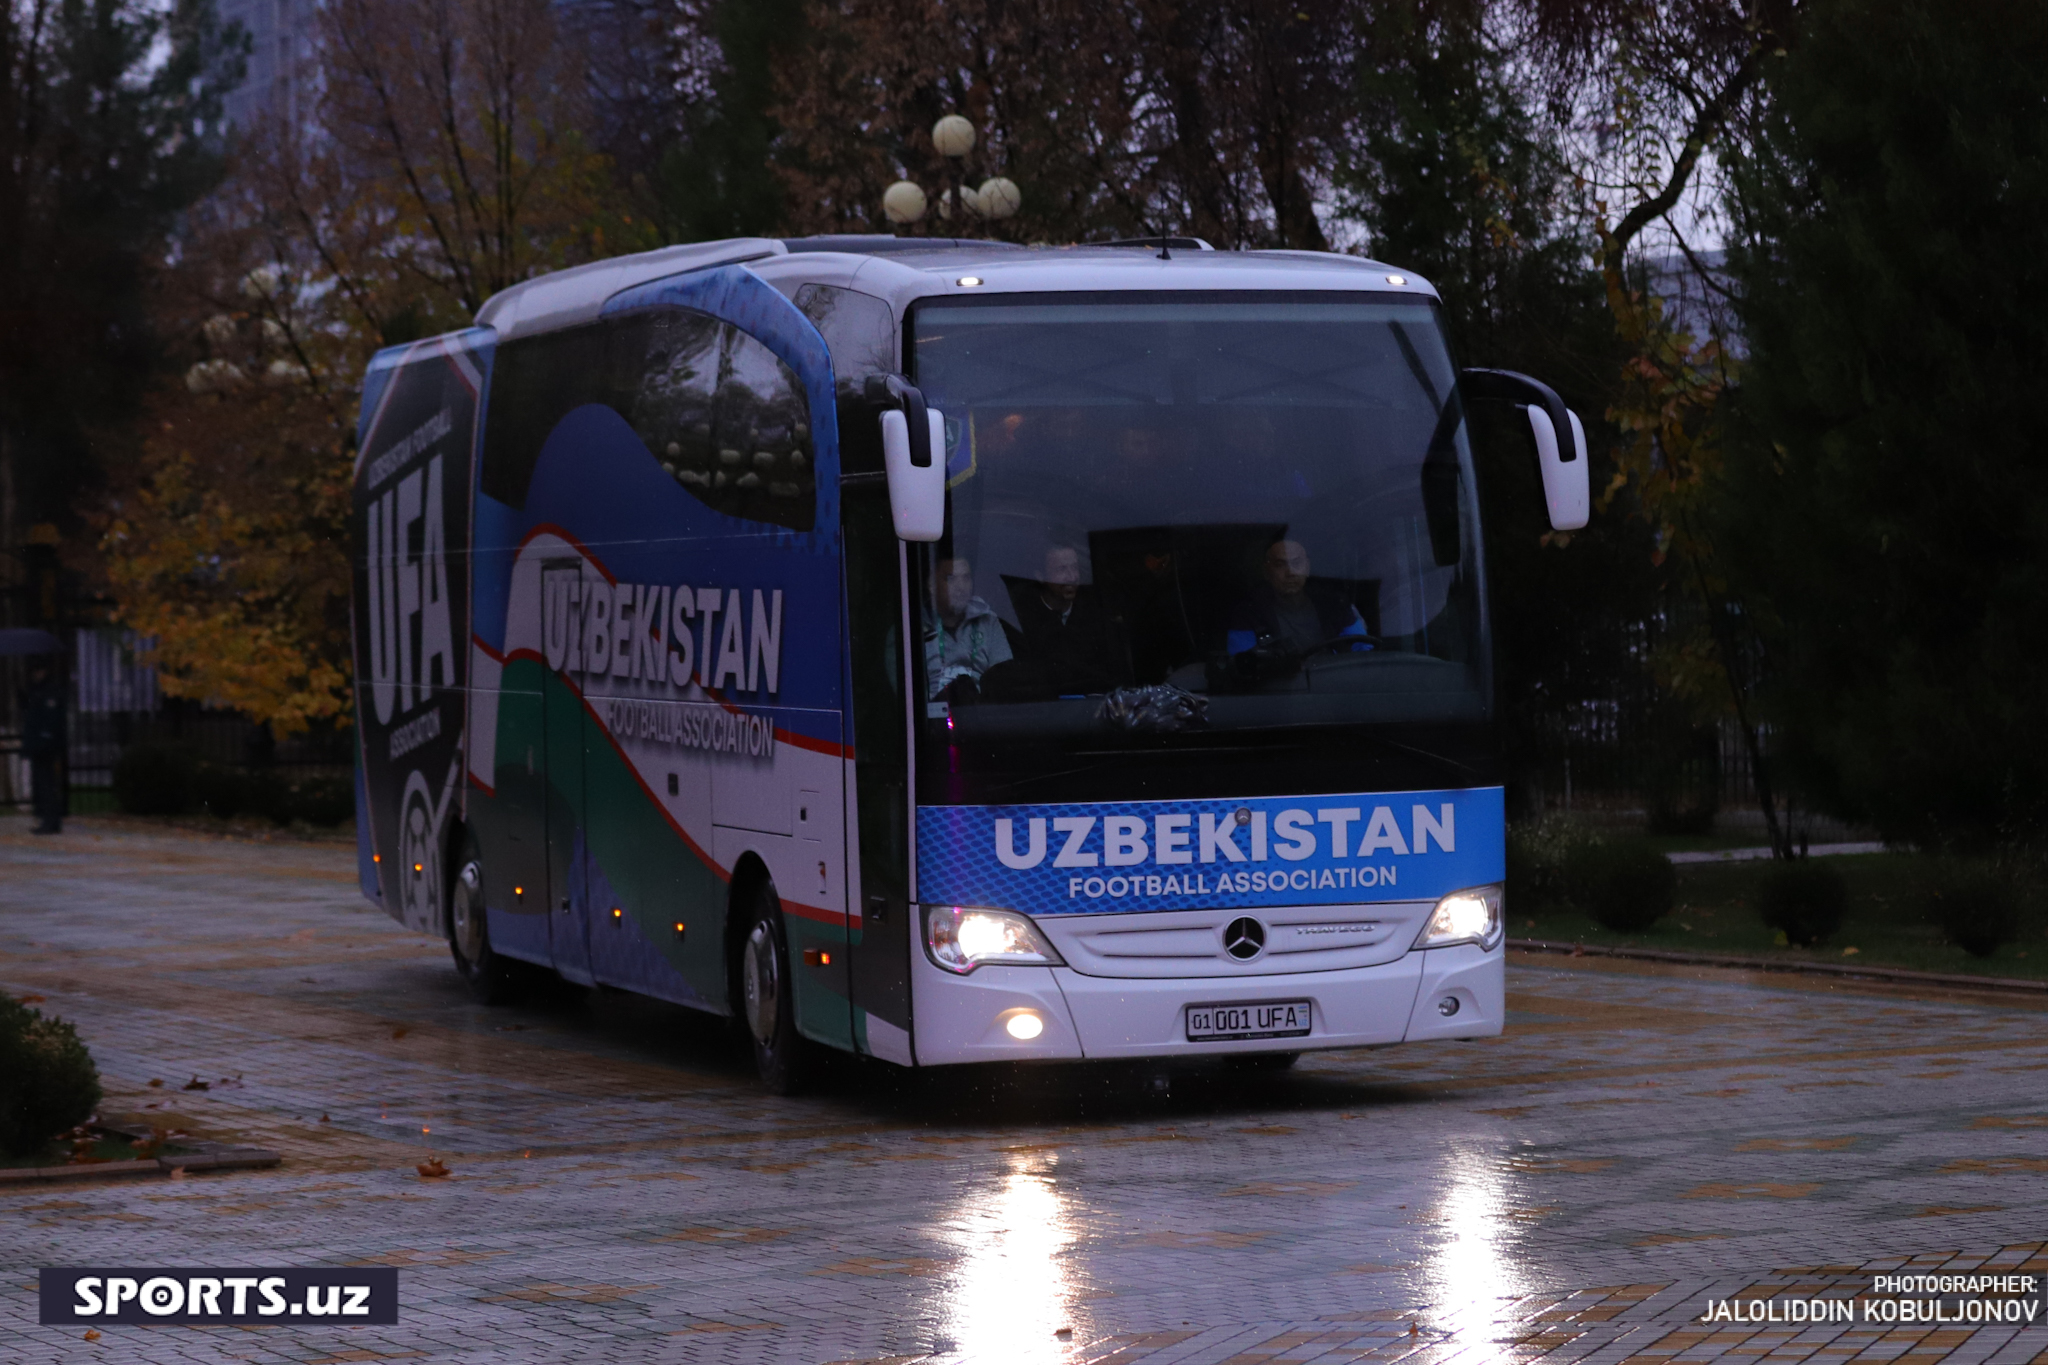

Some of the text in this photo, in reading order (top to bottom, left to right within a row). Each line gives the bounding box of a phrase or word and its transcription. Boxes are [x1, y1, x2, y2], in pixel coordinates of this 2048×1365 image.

[368, 453, 455, 725] UFA
[544, 580, 782, 693] UZBEKISTAN
[673, 706, 774, 757] ASSOCIATION
[994, 803, 1455, 870] UZBEKISTAN
[1068, 865, 1397, 899] FOOTBALL ASSOCIATION
[1193, 1006, 1297, 1031] 01 001 UFA
